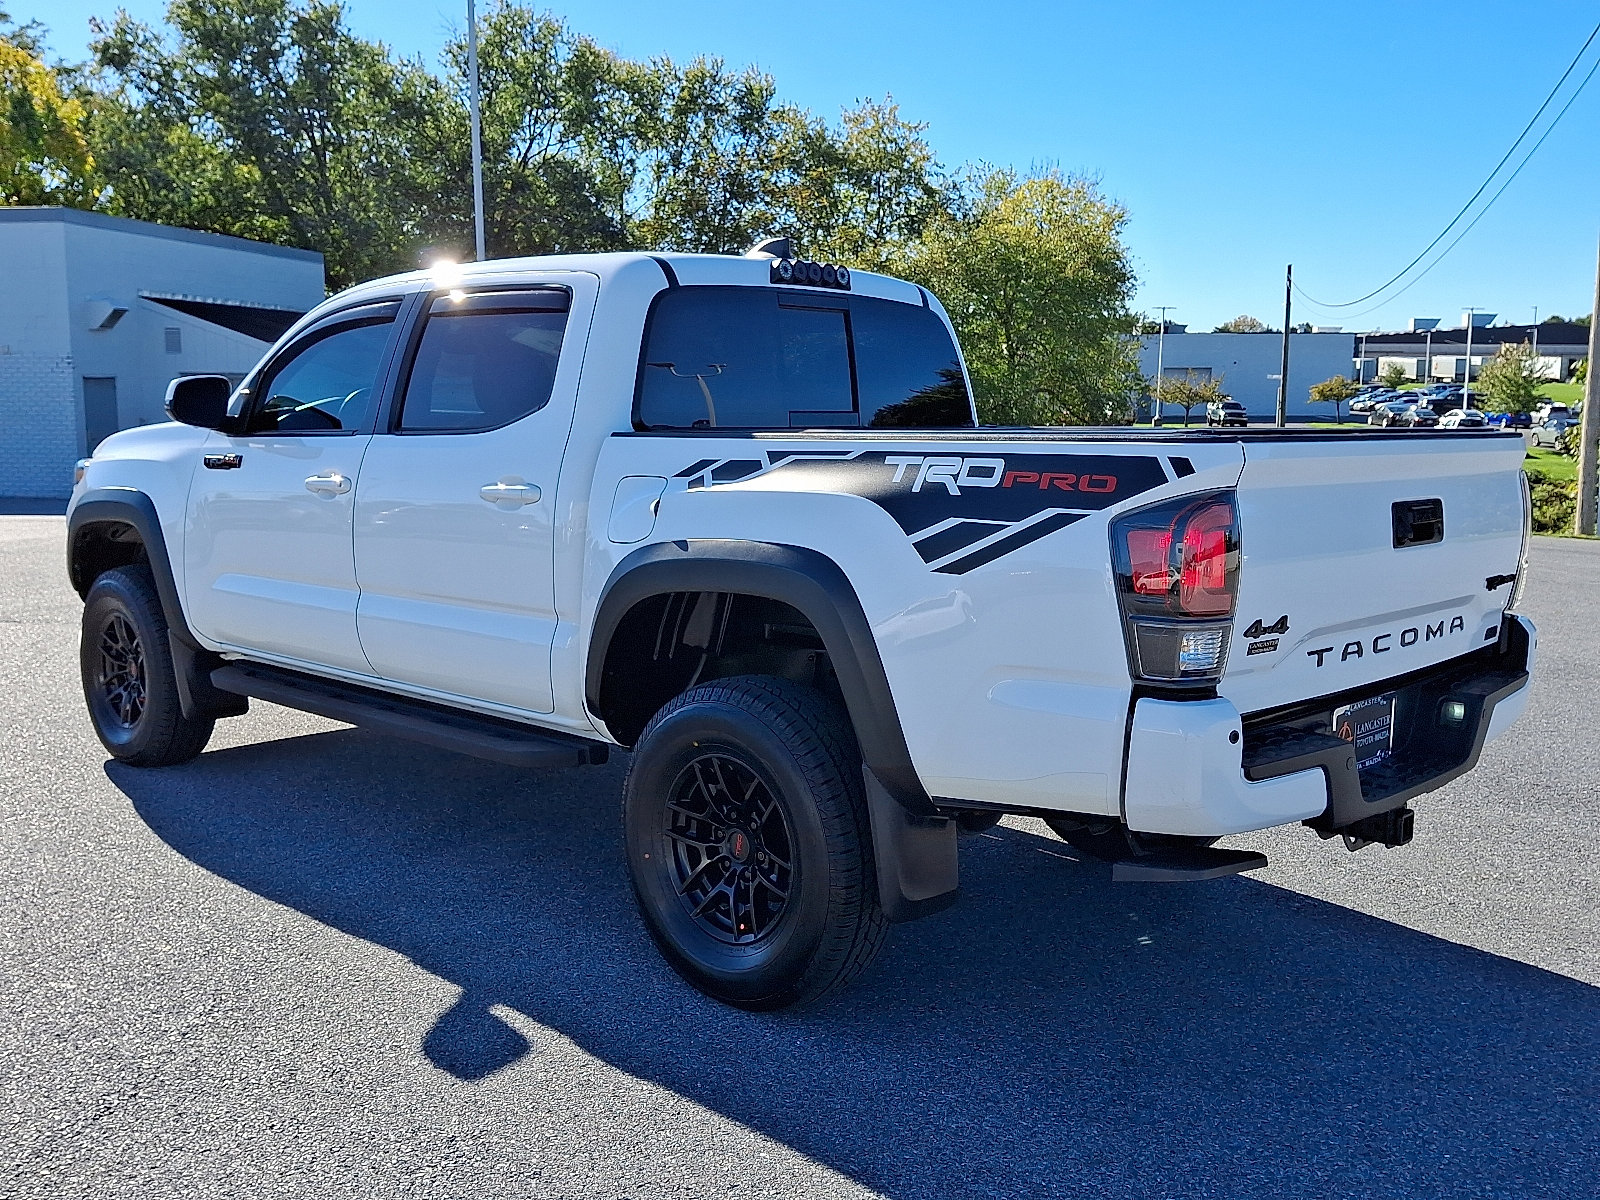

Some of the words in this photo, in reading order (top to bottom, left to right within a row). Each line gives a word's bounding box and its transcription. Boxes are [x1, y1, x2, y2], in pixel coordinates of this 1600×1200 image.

[885, 455, 1005, 495] TRD
[1002, 471, 1117, 493] PRO
[1307, 615, 1465, 668] TACOMA
[1350, 697, 1381, 711] LANCASTER
[1357, 715, 1390, 734] LANCASTER
